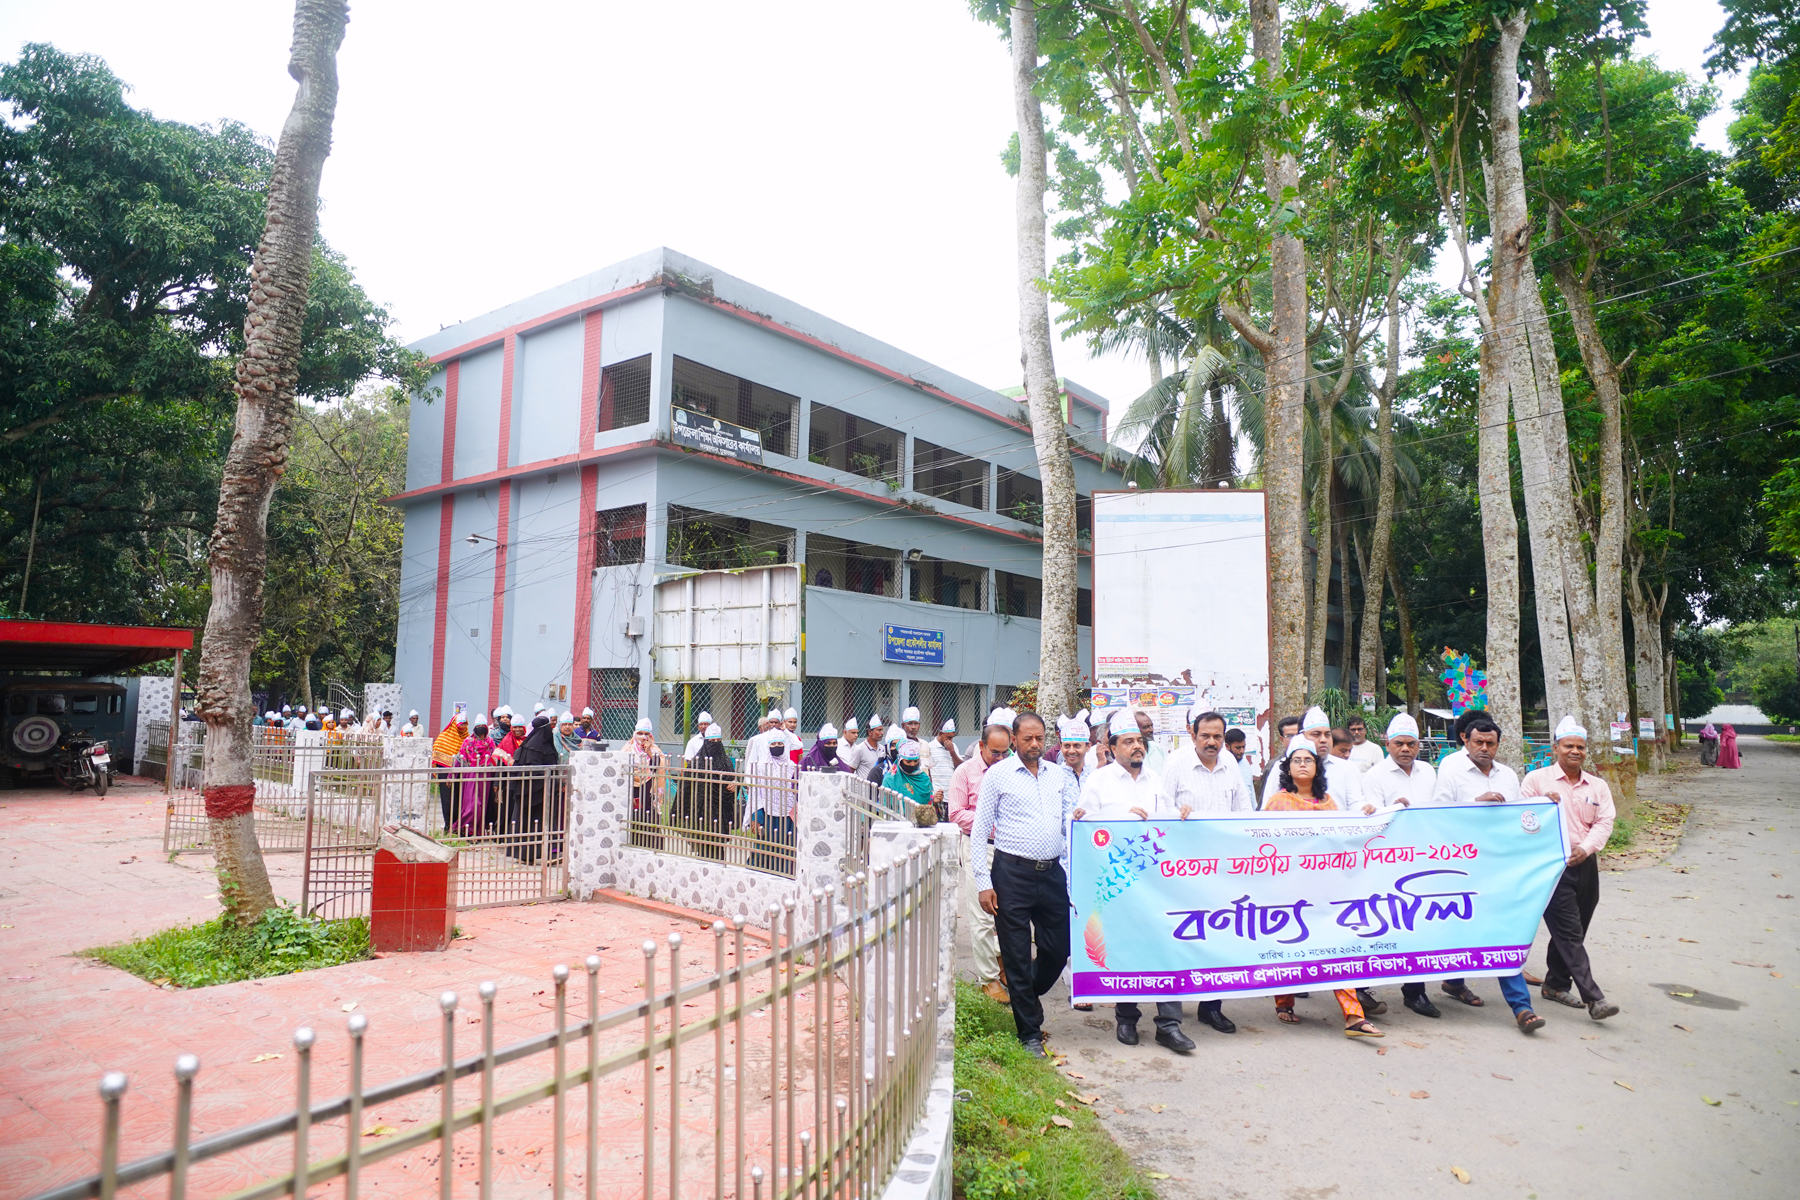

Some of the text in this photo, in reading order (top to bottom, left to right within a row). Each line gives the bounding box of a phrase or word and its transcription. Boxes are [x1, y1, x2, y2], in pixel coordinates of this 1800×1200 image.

[1274, 828, 1282, 838] ও
[1320, 826, 1336, 836] দেশ
[1337, 825, 1363, 836] গড়বে
[1160, 858, 1220, 878] ৫৪তম
[1226, 843, 1292, 876] জাতীয়
[1298, 850, 1358, 872] সমবায়
[1165, 894, 1314, 945] বর্ণাঢ্য
[1258, 949, 1284, 960] তারিখ
[1294, 950, 1306, 958] ০১
[1309, 947, 1337, 956] নভেম্বর
[1369, 942, 1397, 951] শনিবার
[1099, 975, 1176, 990] আয়োজনে
[1189, 970, 1250, 987] উপজেলা
[1253, 965, 1303, 984] প্রশাসন
[1306, 966, 1318, 978] ও
[1322, 961, 1364, 975] সমবায়
[1368, 956, 1412, 973] বিভাগ,
[1415, 951, 1478, 971] দামুড়হুদা,
